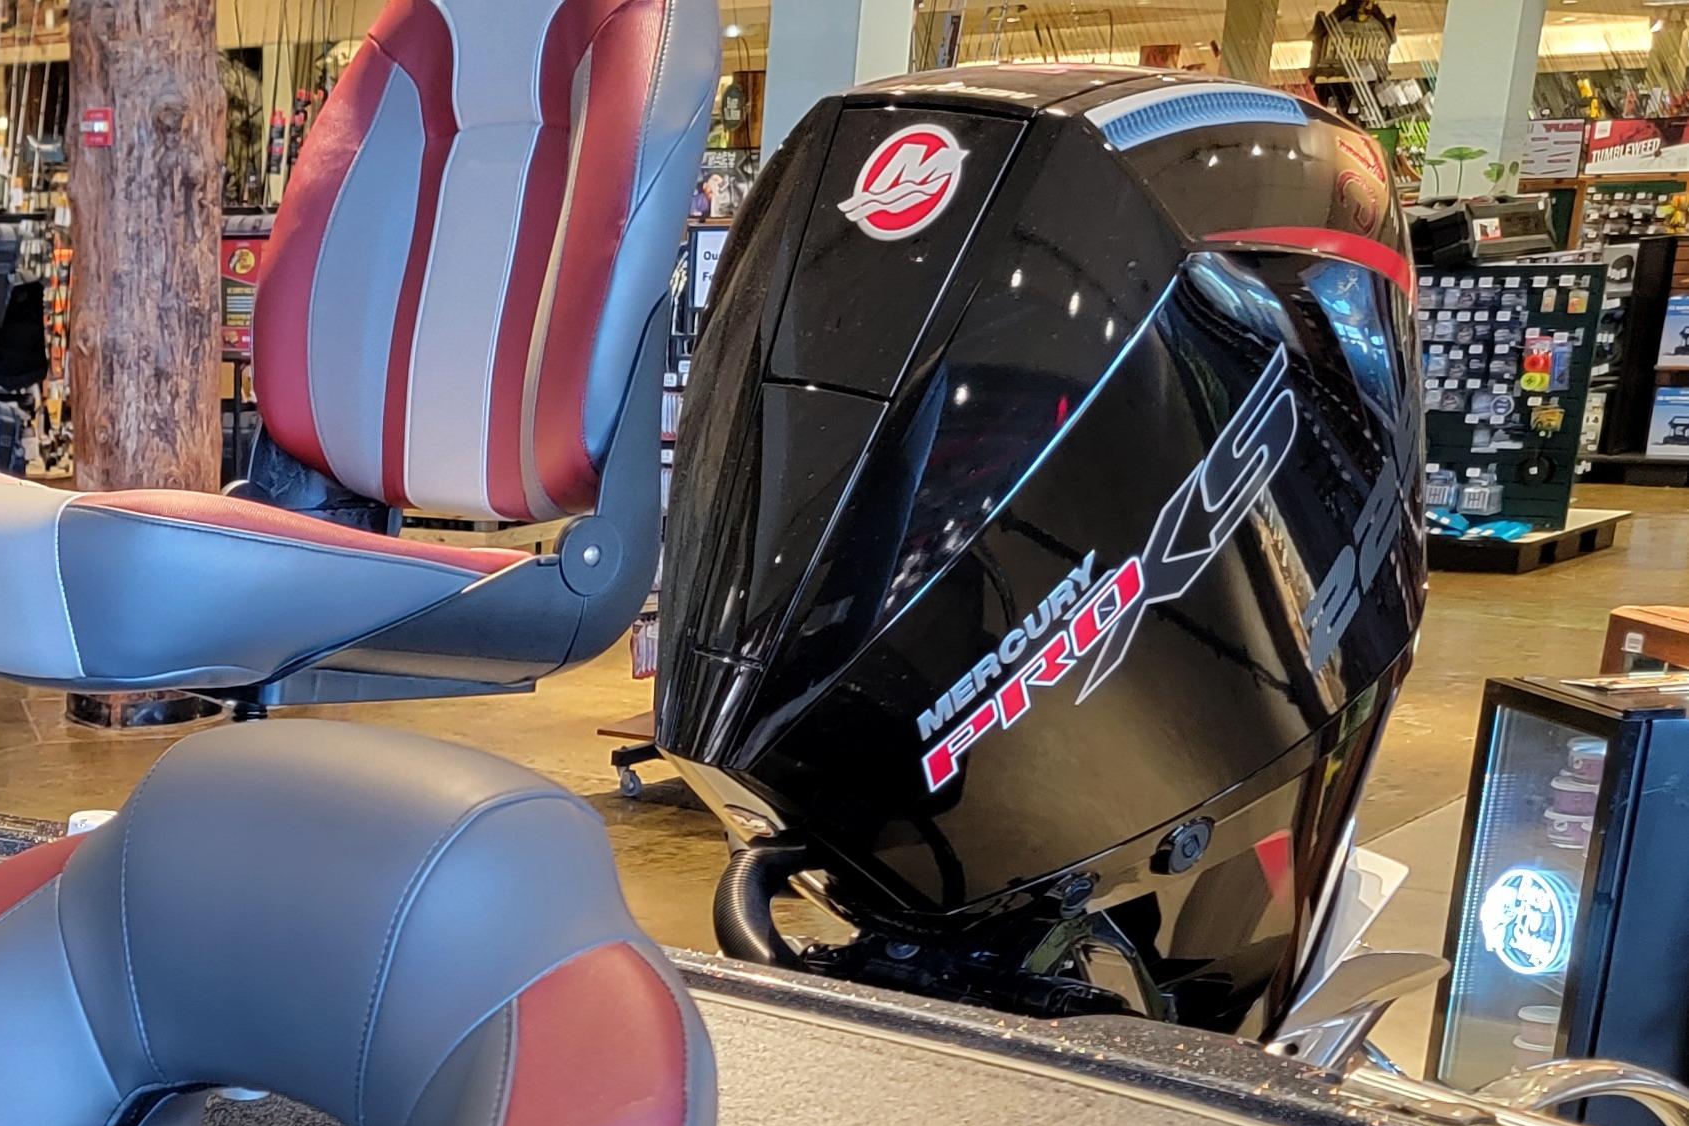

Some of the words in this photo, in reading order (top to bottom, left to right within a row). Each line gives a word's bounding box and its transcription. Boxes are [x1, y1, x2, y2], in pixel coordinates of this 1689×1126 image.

[1324, 36, 1387, 60] FHING
[1592, 138, 1661, 163] TUMBLEWEED
[916, 549, 1096, 742] MERCURY
[921, 555, 1145, 793] PRO
